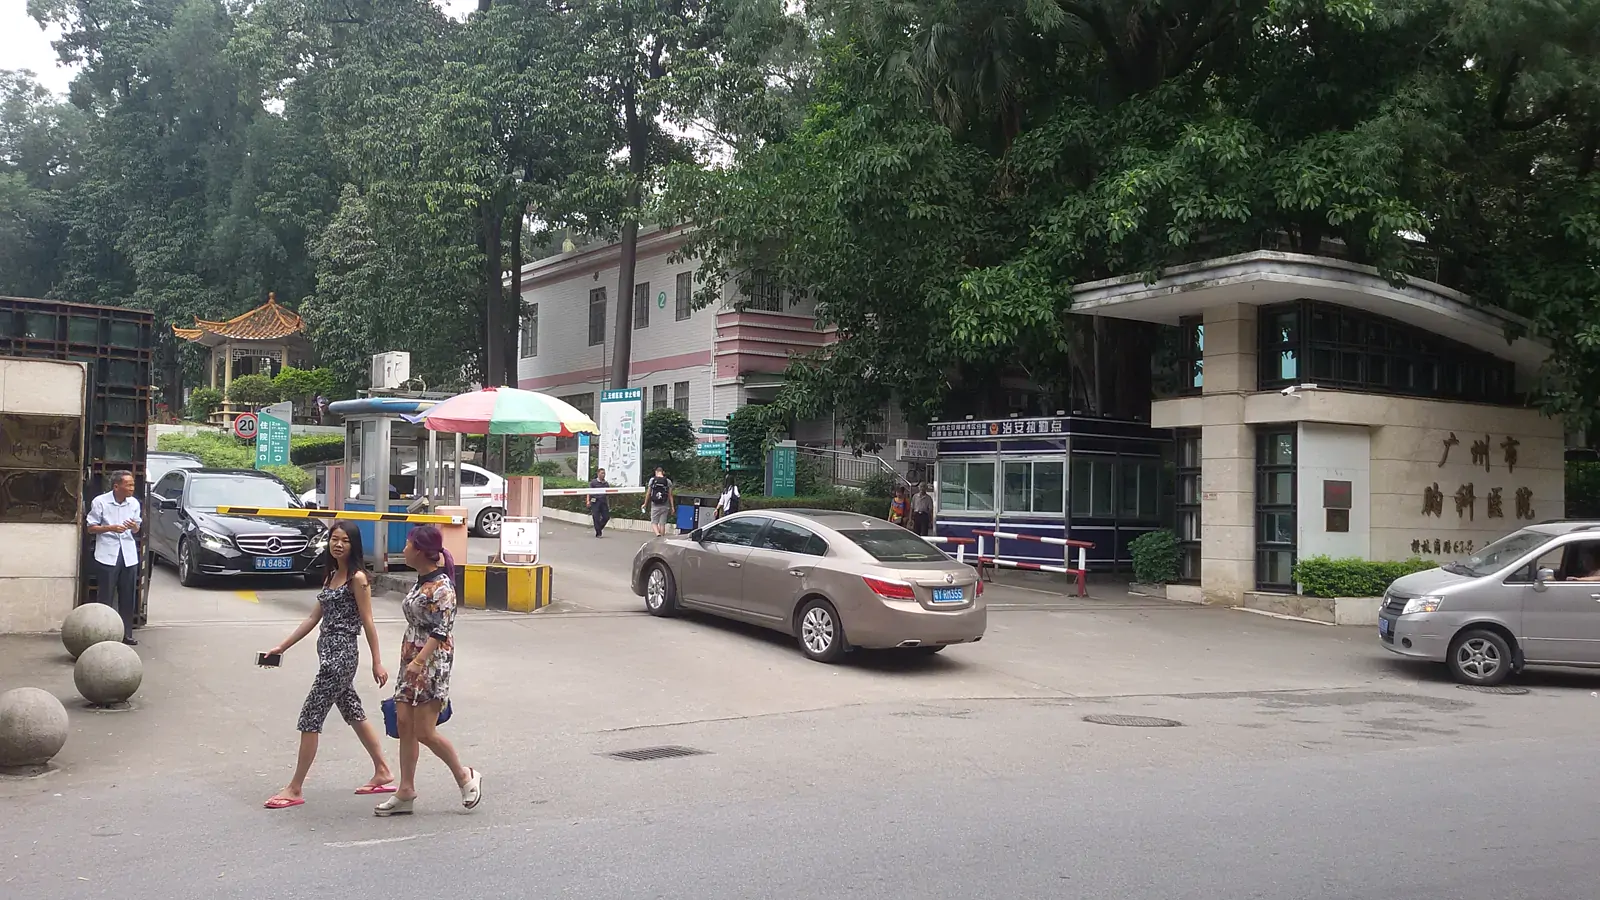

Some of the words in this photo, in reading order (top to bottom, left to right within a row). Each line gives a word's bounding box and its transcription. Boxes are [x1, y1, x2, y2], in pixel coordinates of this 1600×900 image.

[660, 293, 665, 307] 2
[239, 420, 254, 431] 20
[259, 421, 268, 452] 住院部
[1002, 420, 1062, 434] 治安执勤点
[1438, 432, 1520, 473] 广州市
[1421, 482, 1535, 521] 胸科医院
